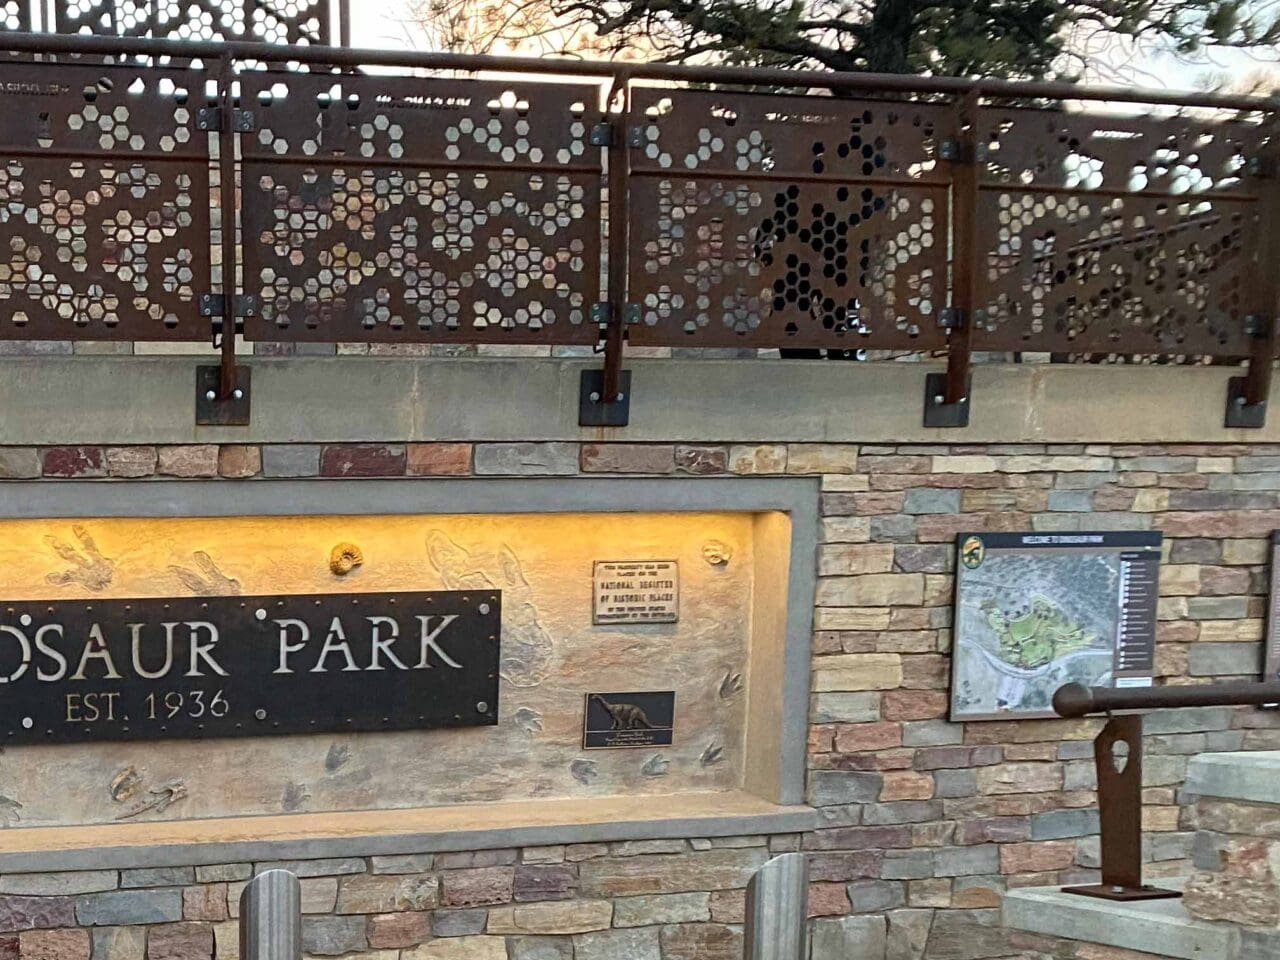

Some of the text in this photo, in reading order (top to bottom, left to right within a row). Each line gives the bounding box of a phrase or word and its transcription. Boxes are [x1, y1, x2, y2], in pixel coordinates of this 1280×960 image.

[272, 614, 464, 674] PARK
[65, 689, 229, 722] EST. 1936
